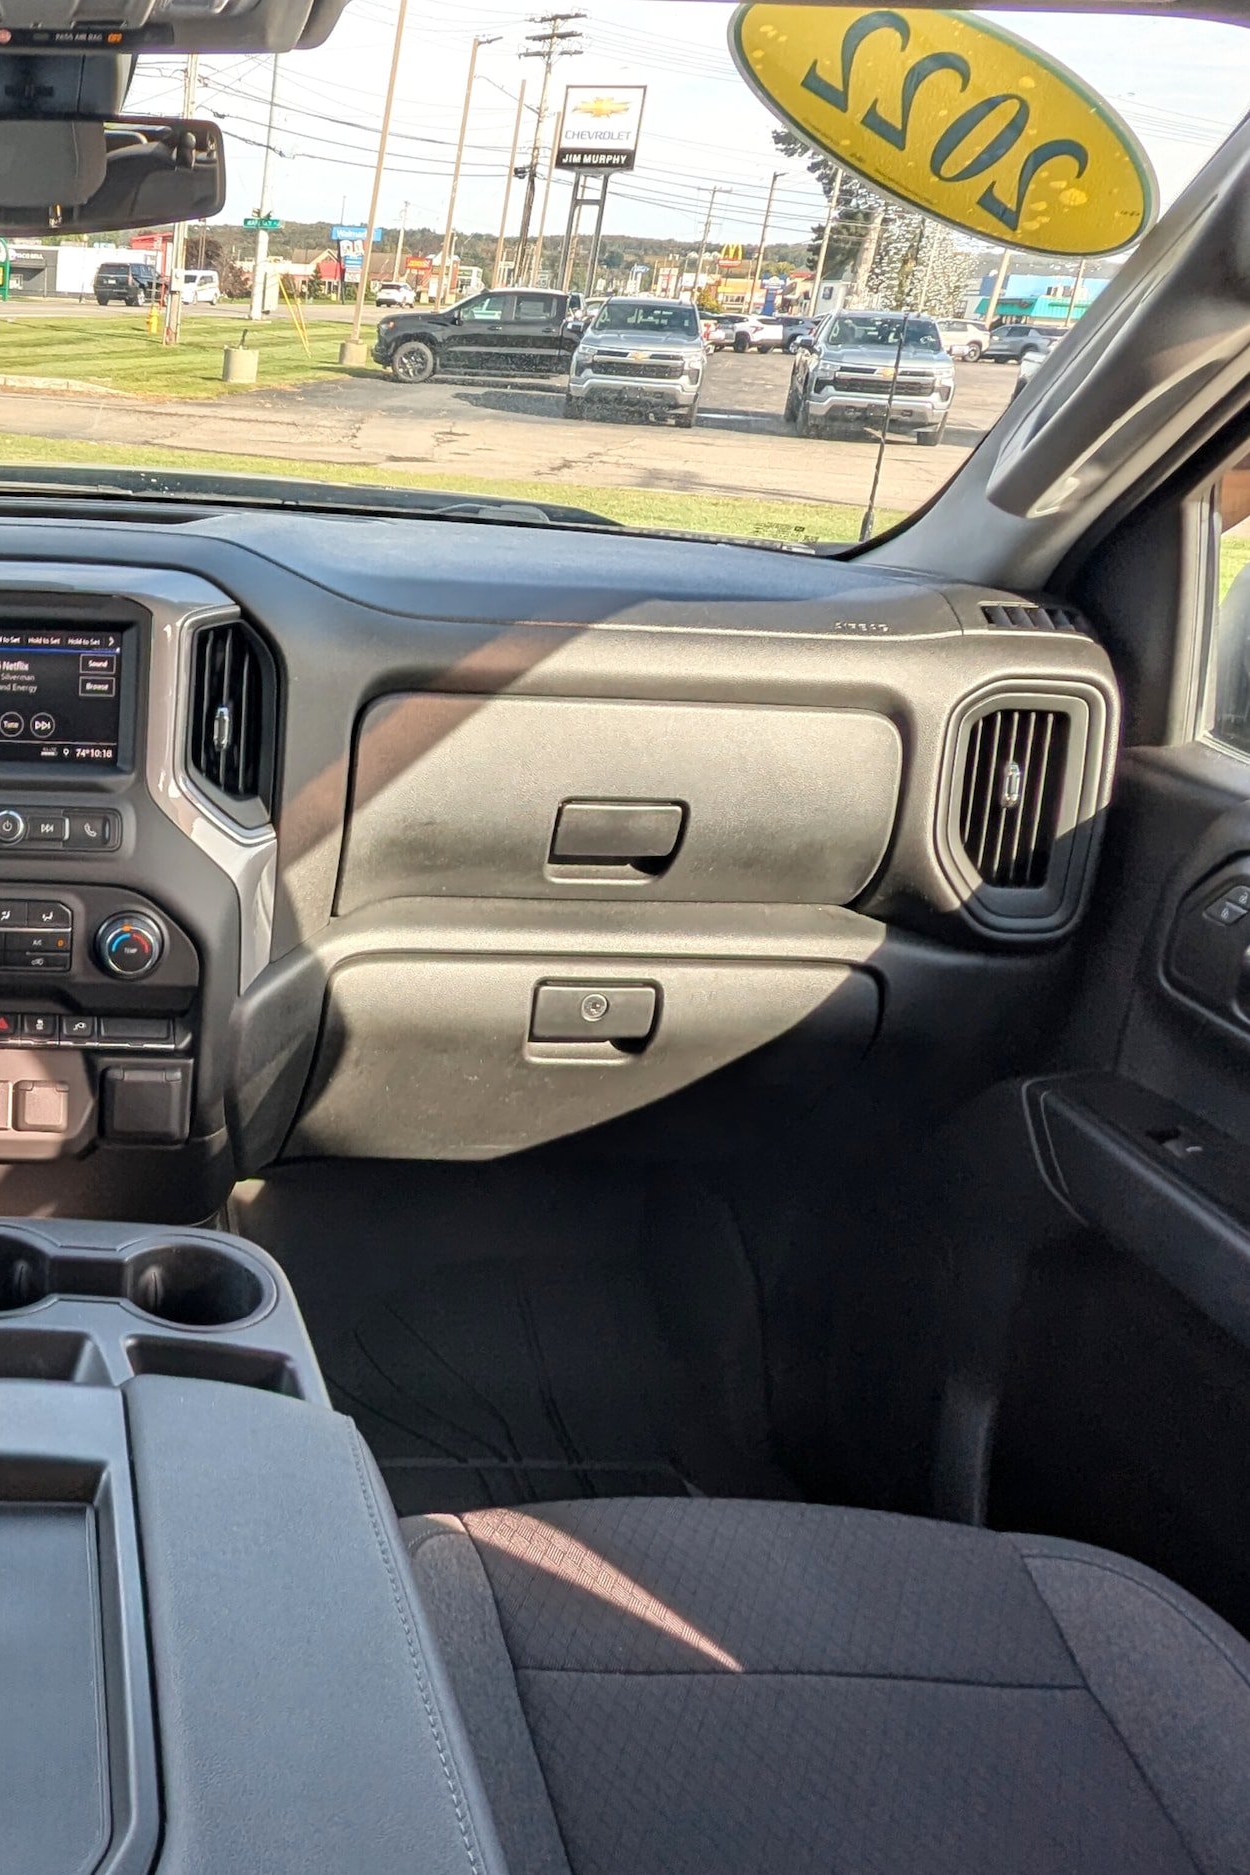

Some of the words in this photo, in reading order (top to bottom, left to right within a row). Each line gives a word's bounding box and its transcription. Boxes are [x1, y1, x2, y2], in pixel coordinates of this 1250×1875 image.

[565, 130, 631, 140] CHEVROLET
[562, 154, 582, 164] JIM
[583, 154, 627, 164] MURPHY
[2, 660, 29, 671] Netflix
[1, 673, 35, 682] Silverman
[12, 683, 38, 693] Energy
